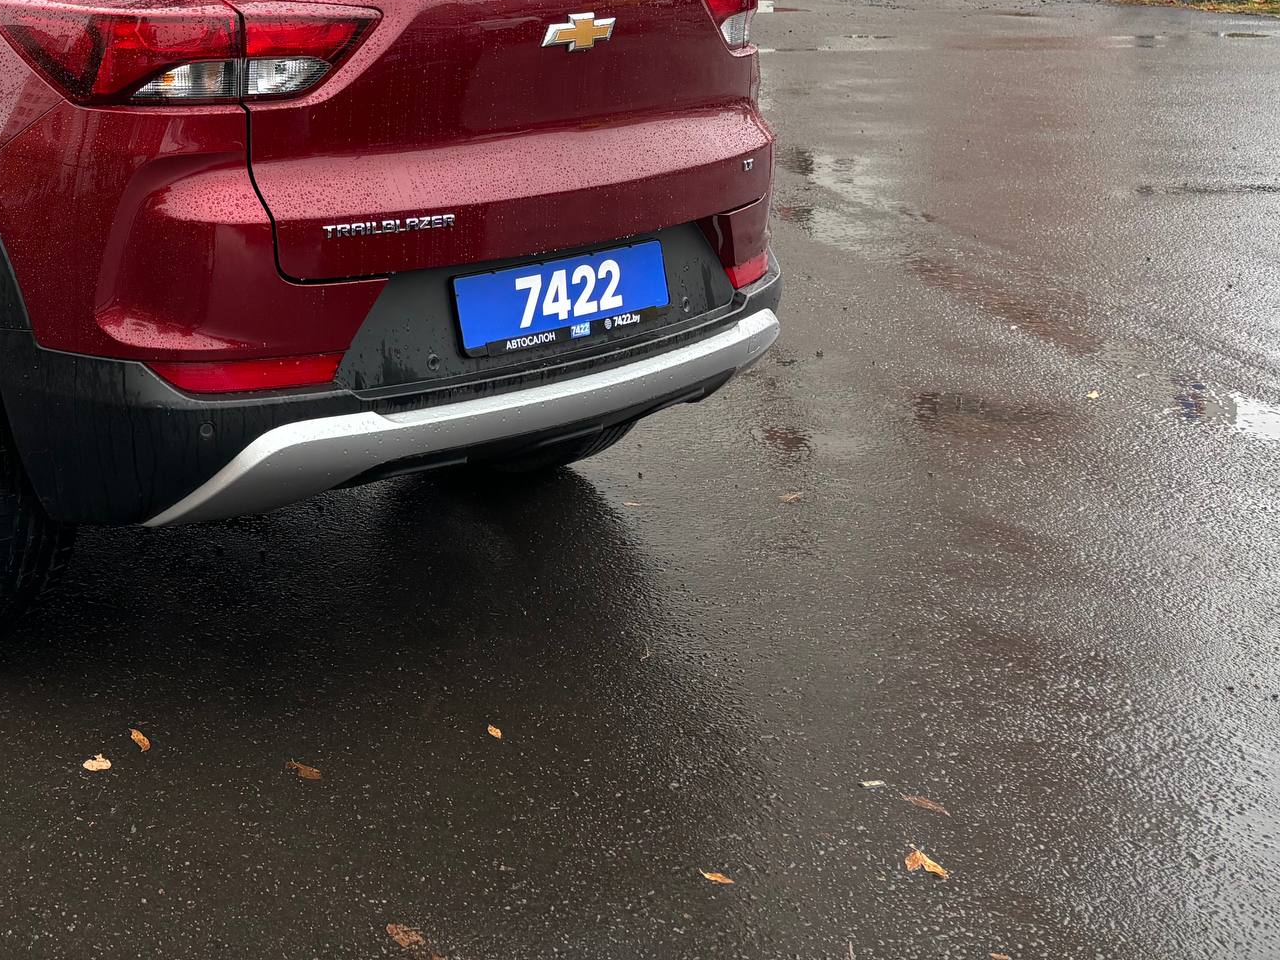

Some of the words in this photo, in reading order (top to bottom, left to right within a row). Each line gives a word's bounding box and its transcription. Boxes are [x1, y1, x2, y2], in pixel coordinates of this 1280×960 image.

[322, 214, 456, 239] TRAILBLAZER
[515, 259, 623, 329] 7422
[570, 322, 591, 337] 7422
[612, 313, 641, 327] 7422.by
[506, 331, 556, 350] АВТОСАЛОН
